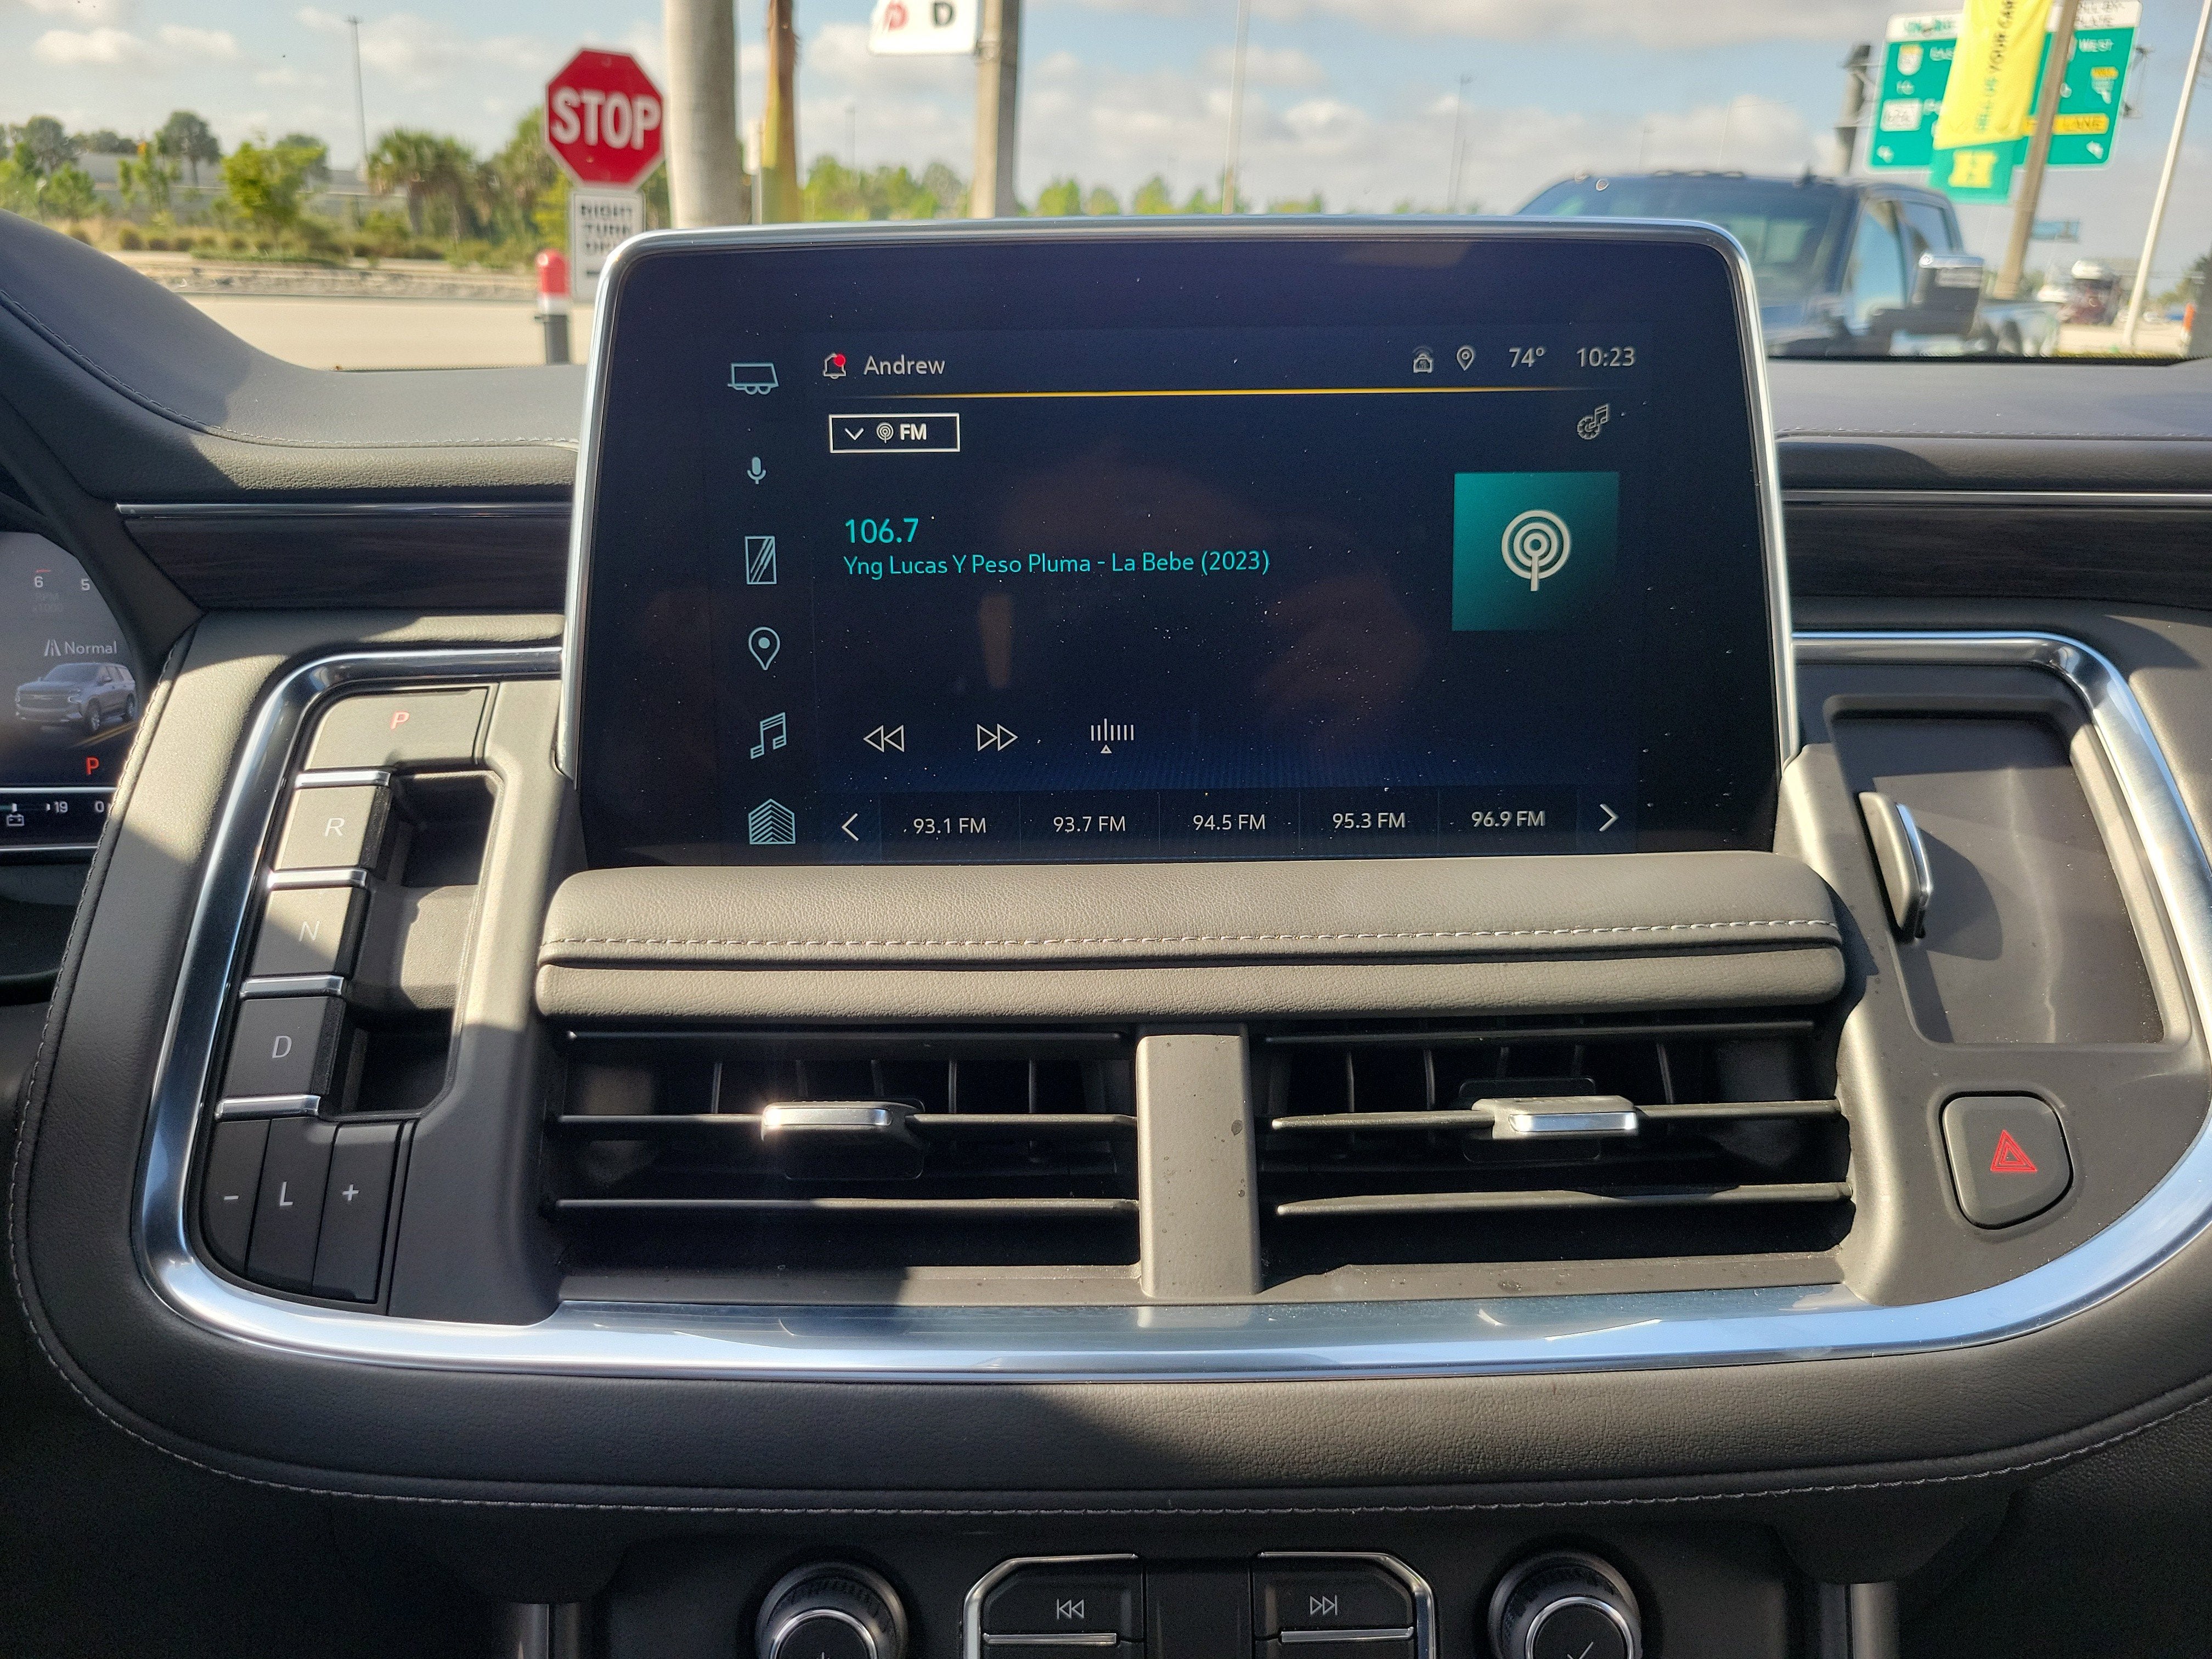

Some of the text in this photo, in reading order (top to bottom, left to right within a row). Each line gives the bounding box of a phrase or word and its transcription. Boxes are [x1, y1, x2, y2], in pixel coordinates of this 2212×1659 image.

[550, 86, 662, 150] STOP
[863, 353, 946, 376] Andrew
[1508, 346, 1546, 369] 74°
[1576, 347, 1635, 368] 10:23
[899, 422, 927, 441] FM
[844, 517, 919, 544] 106.7
[843, 556, 883, 581] Yng
[889, 555, 948, 574] Lucas
[952, 554, 967, 574] Y
[972, 554, 1022, 574] Peso
[1028, 552, 1091, 573] Pluma
[1112, 552, 1136, 572] La
[1142, 550, 1194, 572] Bebe
[1201, 549, 1271, 576] (2023)
[34, 575, 43, 588] 6
[81, 578, 90, 591] 5
[64, 640, 117, 655] Normal
[389, 710, 411, 731] P
[86, 757, 99, 775] P
[54, 801, 68, 813] 19
[324, 817, 346, 837] R
[913, 817, 987, 834] 93.1 FM
[1053, 815, 1126, 833] 93.7 FM
[1192, 813, 1266, 831] 94.5 FM
[1332, 811, 1406, 830] 95.3 FM
[1471, 810, 1544, 828] 96.9 FM
[299, 921, 320, 942] N
[271, 1035, 292, 1059] D
[279, 1181, 294, 1207] L
